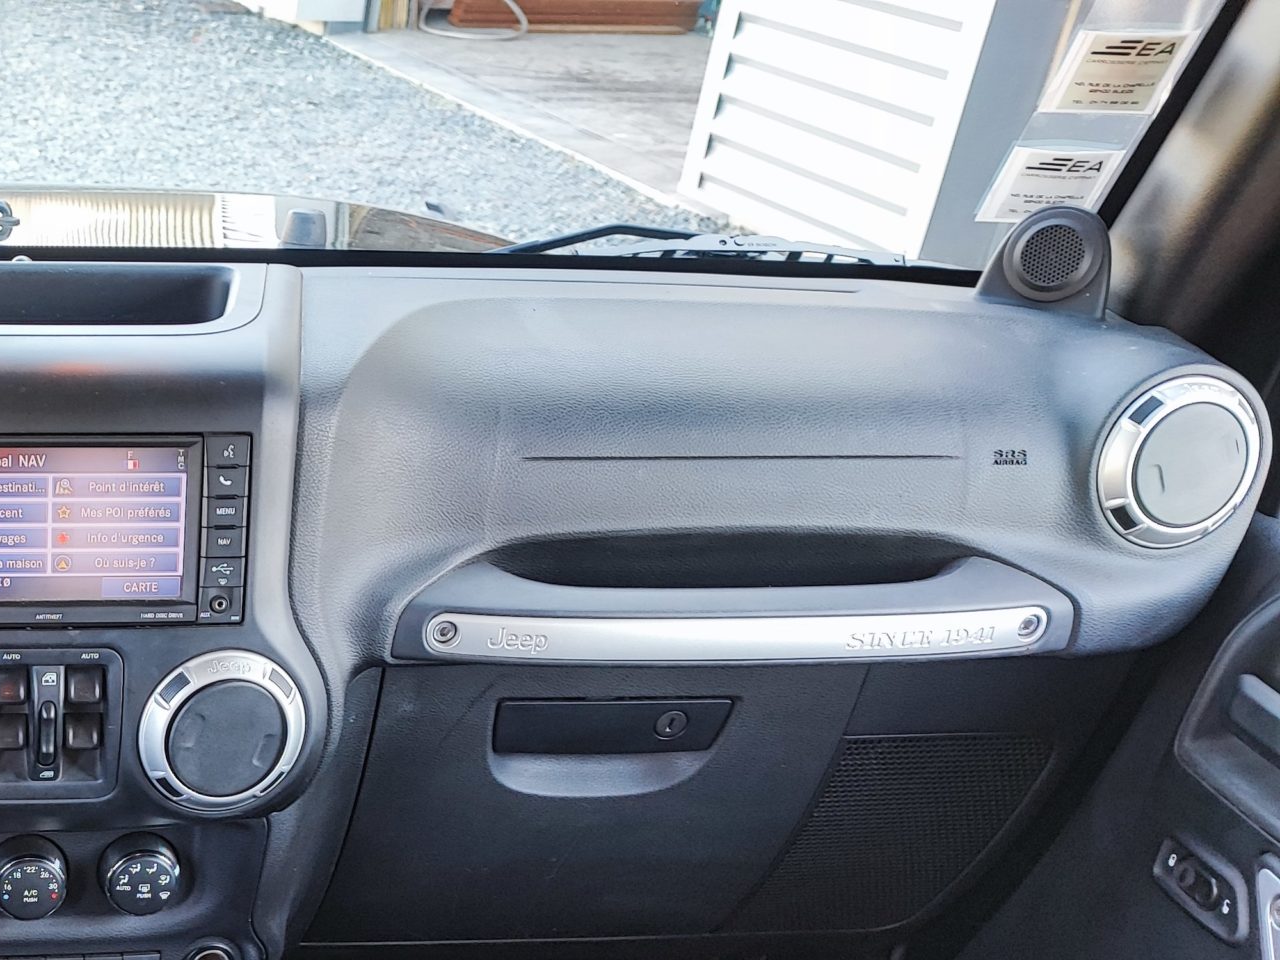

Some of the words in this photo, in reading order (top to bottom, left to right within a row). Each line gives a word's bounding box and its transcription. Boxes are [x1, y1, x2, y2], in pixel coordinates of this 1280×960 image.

[993, 449, 1027, 458] SRS
[18, 454, 46, 468] NAV
[89, 481, 116, 492] Point
[119, 480, 165, 492] d'intérêt
[81, 507, 102, 518] Mes
[105, 507, 124, 517] POI
[127, 507, 171, 519] préférés
[87, 532, 108, 543] Info
[111, 532, 164, 545] d'urgence
[6, 558, 43, 569] maison
[94, 557, 109, 568] Où
[112, 557, 147, 570] suis-je
[149, 557, 156, 568] ?
[123, 582, 159, 593] CARTE
[488, 626, 549, 655] Jeep
[939, 625, 996, 647] 1941
[13, 871, 21, 879] 18
[23, 889, 38, 897] A/C
